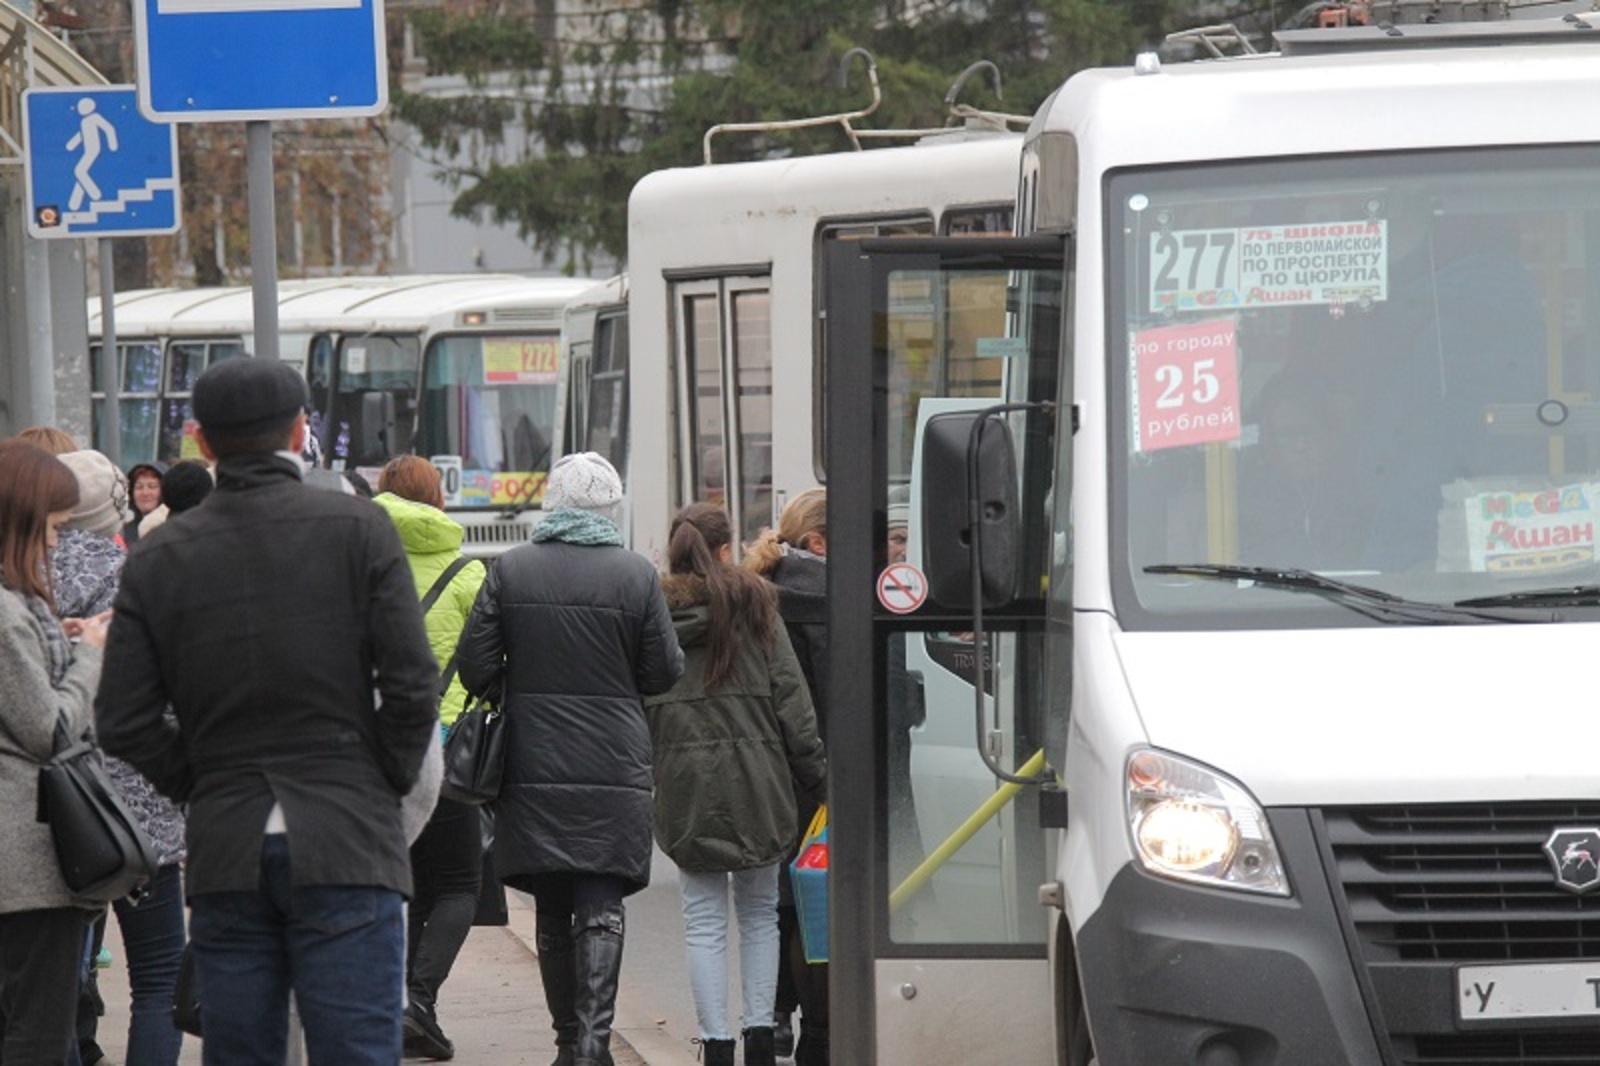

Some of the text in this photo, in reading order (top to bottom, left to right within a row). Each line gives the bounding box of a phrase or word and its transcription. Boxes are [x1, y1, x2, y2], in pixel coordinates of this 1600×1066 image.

[1243, 236, 1383, 257] ПО ПЕРВОМАЙСКОЙ
[1153, 232, 1236, 292] 277
[1243, 252, 1382, 272] ПО ПРОСПЕКТУ
[1260, 268, 1382, 287] ПО ЦЮРУПА
[523, 342, 554, 372] 272
[1137, 332, 1234, 355] по городу
[1155, 358, 1220, 409] 25
[1148, 406, 1235, 439] рублей
[1485, 519, 1594, 551] Ашан
